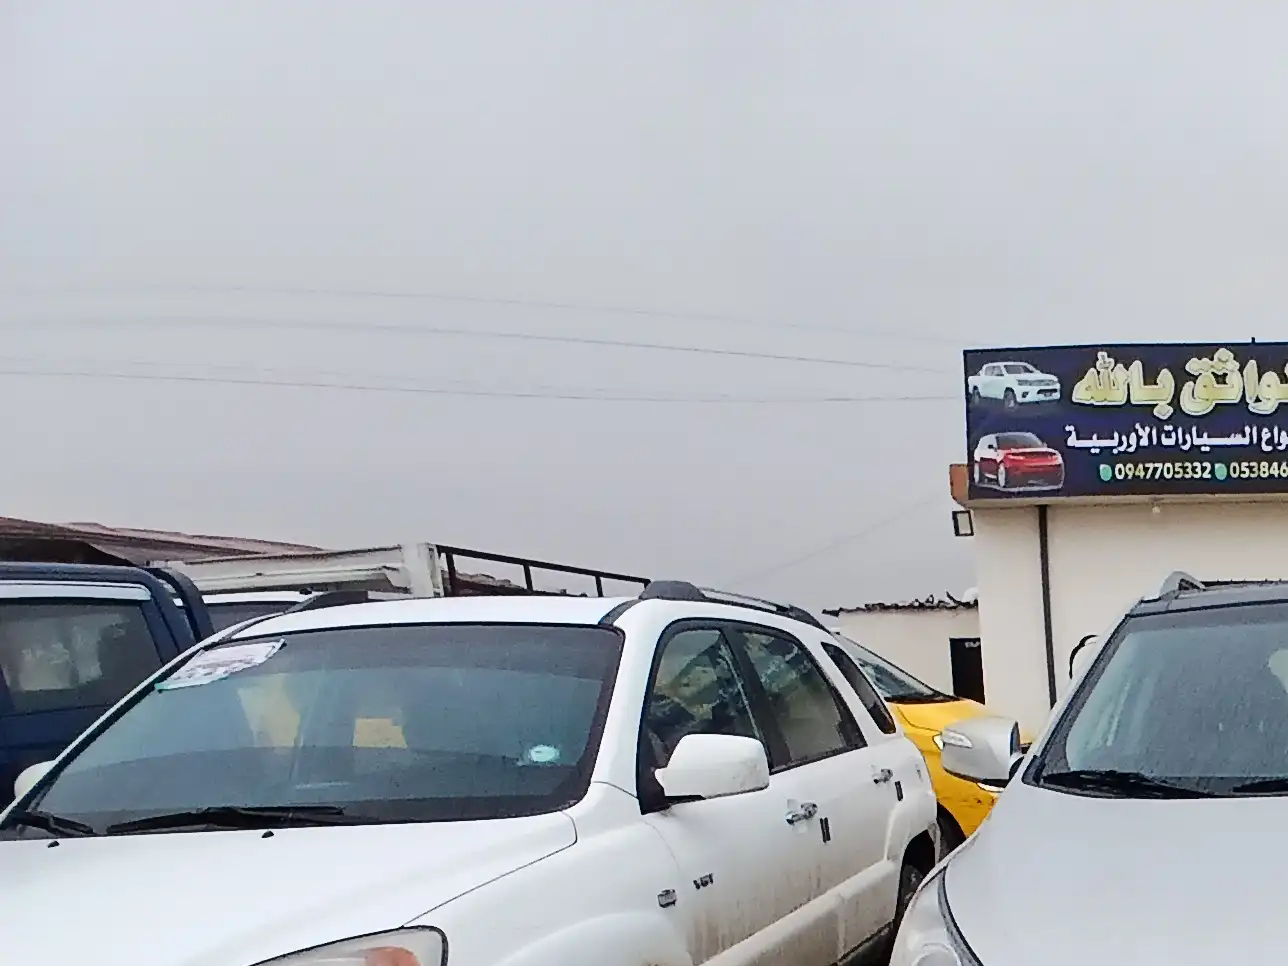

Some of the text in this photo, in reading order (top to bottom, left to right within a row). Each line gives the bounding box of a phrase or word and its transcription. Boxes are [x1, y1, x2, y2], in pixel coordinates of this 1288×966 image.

[1072, 351, 1175, 419] بالله
[1065, 422, 1158, 454] الأوربية
[1161, 424, 1257, 452] السيارات
[1115, 461, 1212, 480] 0947705332
